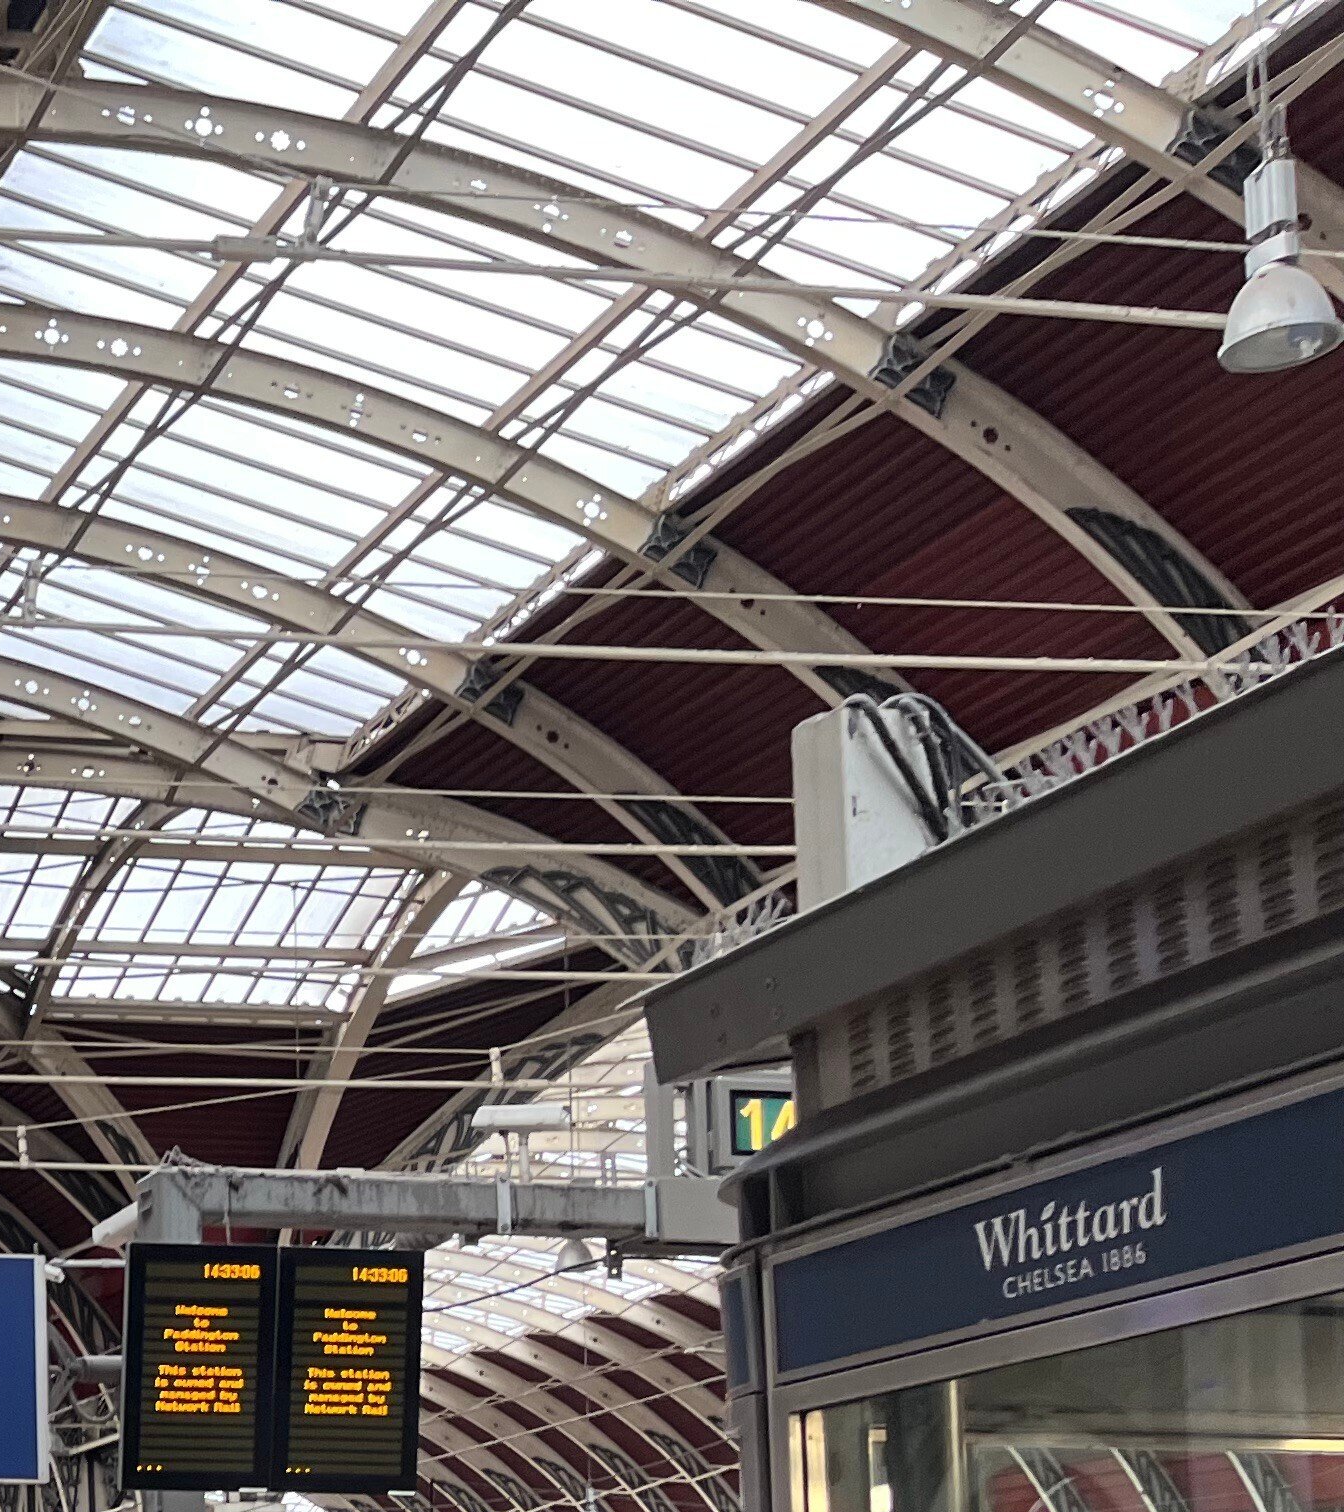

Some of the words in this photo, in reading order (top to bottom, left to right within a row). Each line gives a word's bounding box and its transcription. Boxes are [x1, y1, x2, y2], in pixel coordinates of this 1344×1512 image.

[974, 1166, 1168, 1271] Whittard
[1003, 1257, 1094, 1298] CHELSEA
[1102, 1241, 1148, 1273] 1886
[193, 1317, 210, 1328] to
[343, 1320, 359, 1331] to
[164, 1329, 240, 1341] Paddington
[313, 1332, 387, 1344] Paddington
[175, 1341, 226, 1352] Station
[324, 1344, 375, 1356] Station
[192, 1366, 243, 1377] station
[341, 1369, 390, 1380] station
[155, 1401, 210, 1412] Network
[214, 1402, 241, 1413] Rail
[304, 1403, 358, 1415] Network
[362, 1405, 389, 1416] Rail
